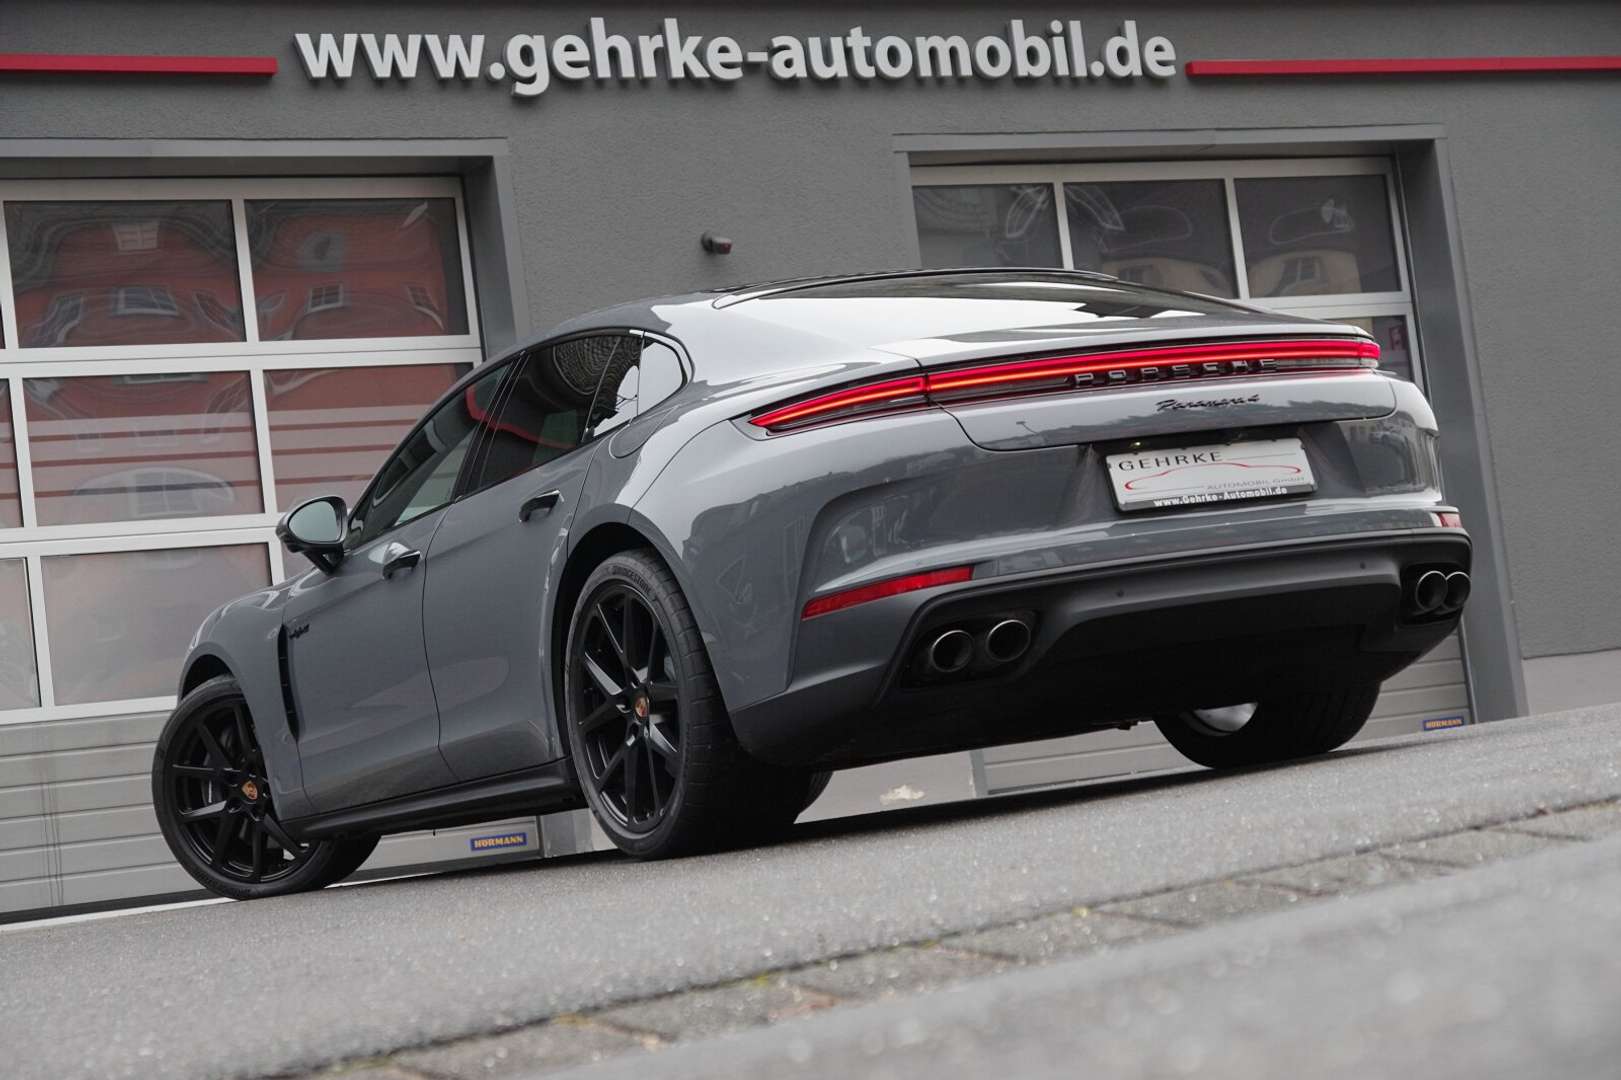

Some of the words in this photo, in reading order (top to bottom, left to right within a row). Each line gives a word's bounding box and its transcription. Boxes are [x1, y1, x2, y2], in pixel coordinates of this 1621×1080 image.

[293, 17, 1177, 97] www.gehrke-automobil.de
[1075, 358, 1277, 387] PORSCHE
[1118, 451, 1223, 472] GEHRKE
[1153, 487, 1287, 507] www.Gehrke-Automobil.de
